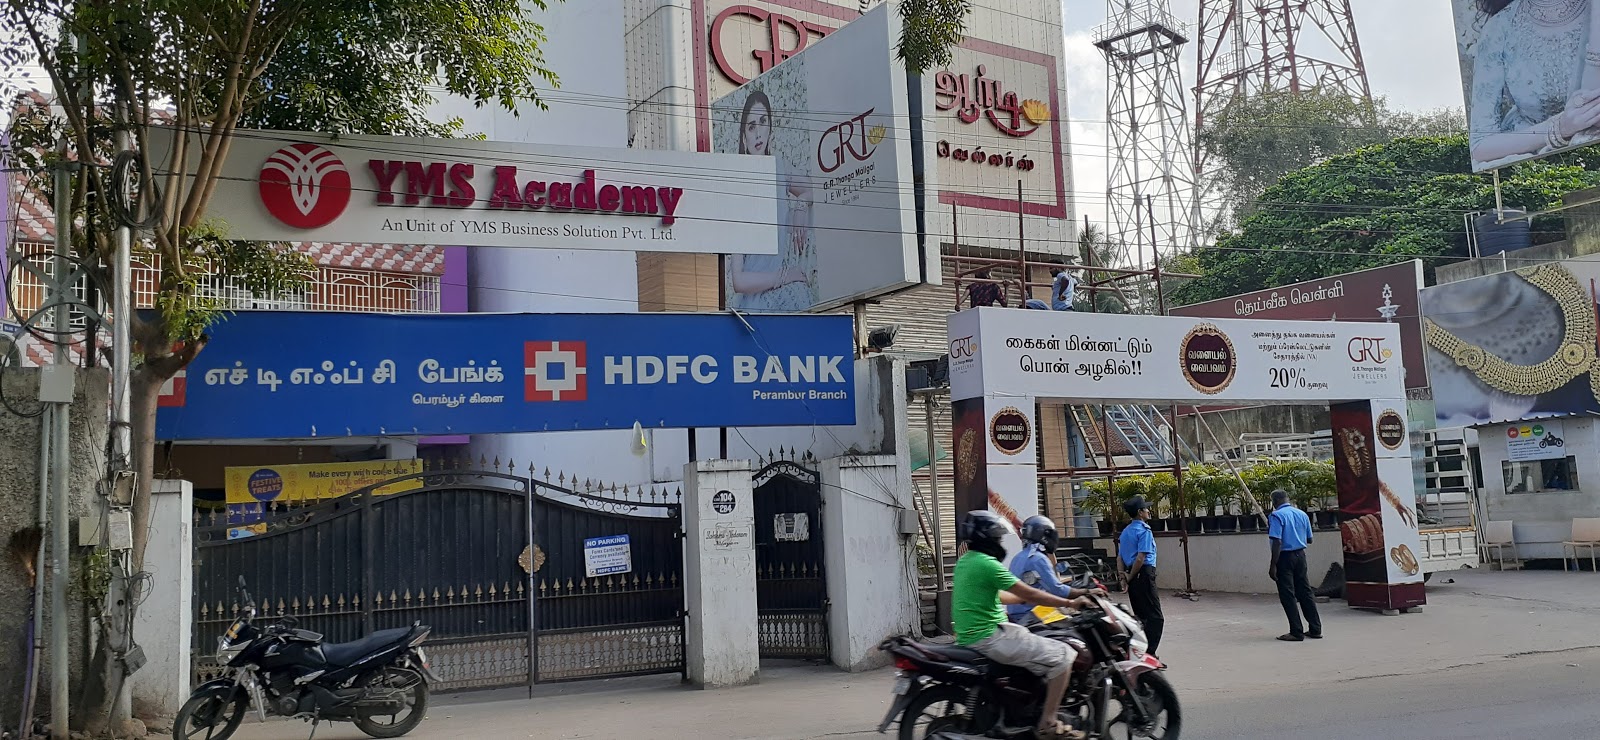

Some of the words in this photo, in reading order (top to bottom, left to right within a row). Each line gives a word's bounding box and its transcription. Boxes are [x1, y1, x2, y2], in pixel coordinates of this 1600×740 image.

[709, 4, 840, 87] GR
[817, 106, 877, 173] GRT
[368, 159, 476, 207] YMS
[489, 165, 684, 226] Academy
[824, 175, 876, 204] JEWELLERS
[381, 218, 403, 231] An
[406, 218, 436, 232] Unit
[440, 219, 455, 232] of
[460, 220, 497, 234] YMS
[501, 221, 559, 237] Business
[563, 224, 618, 239] Solution
[622, 227, 647, 240] Pvt.
[651, 227, 677, 241] Ltd.
[1234, 291, 1288, 316] தெய்வீக
[1290, 280, 1345, 305] வெள்ளி
[951, 335, 975, 359] GRT
[1006, 334, 1060, 351] கைகள்
[1065, 334, 1153, 358] மின்னட்டும்
[1188, 347, 1227, 360] வளையல்
[1347, 336, 1388, 364] GRT
[204, 360, 248, 386] எச்
[256, 366, 283, 392] டி
[290, 360, 364, 385] எஃப்
[372, 359, 396, 384] சி
[417, 358, 504, 384] பேங்க்
[604, 354, 719, 385] HDFC
[733, 355, 846, 384] BANK
[1020, 355, 1070, 374] பொன்
[1075, 358, 1142, 381] அழகில்!!
[1191, 361, 1227, 373] வைபவம்
[412, 391, 466, 408] பெரம்பூர்
[469, 392, 504, 405] கிளை
[753, 390, 806, 400] Perambur
[808, 389, 847, 400] Branch
[251, 476, 282, 488] FESTIVE
[309, 470, 330, 478] Make
[331, 469, 351, 478] every
[252, 484, 281, 495] TREATS
[720, 493, 733, 502] 104
[719, 504, 733, 513] 284
[598, 537, 626, 546] PARKING
